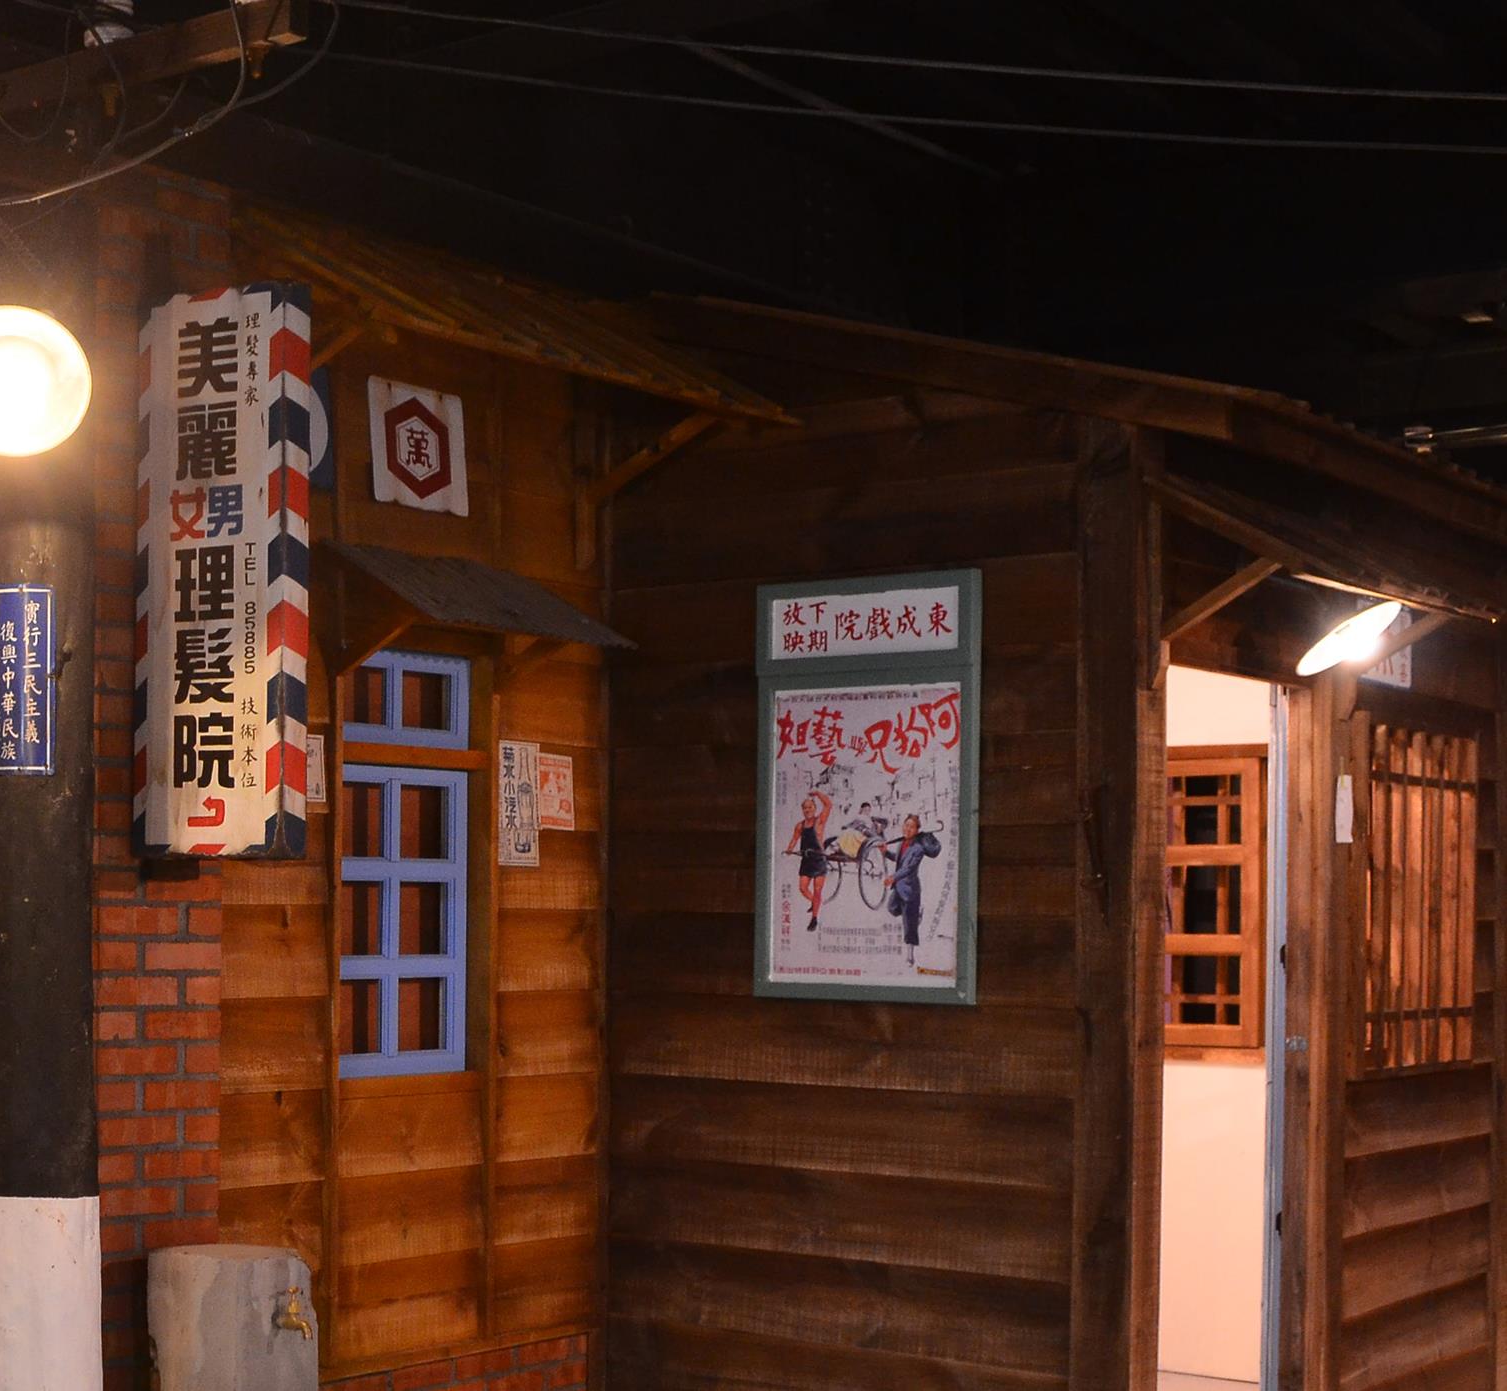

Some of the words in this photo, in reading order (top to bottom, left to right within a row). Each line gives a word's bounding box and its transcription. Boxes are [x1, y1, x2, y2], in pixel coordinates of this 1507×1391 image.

[244, 542, 256, 586] TEL
[244, 602, 256, 675] 85885
[835, 602, 952, 641] 東成戲院
[1, 620, 19, 760] 復興中華民族
[240, 696, 258, 788] 技術本位
